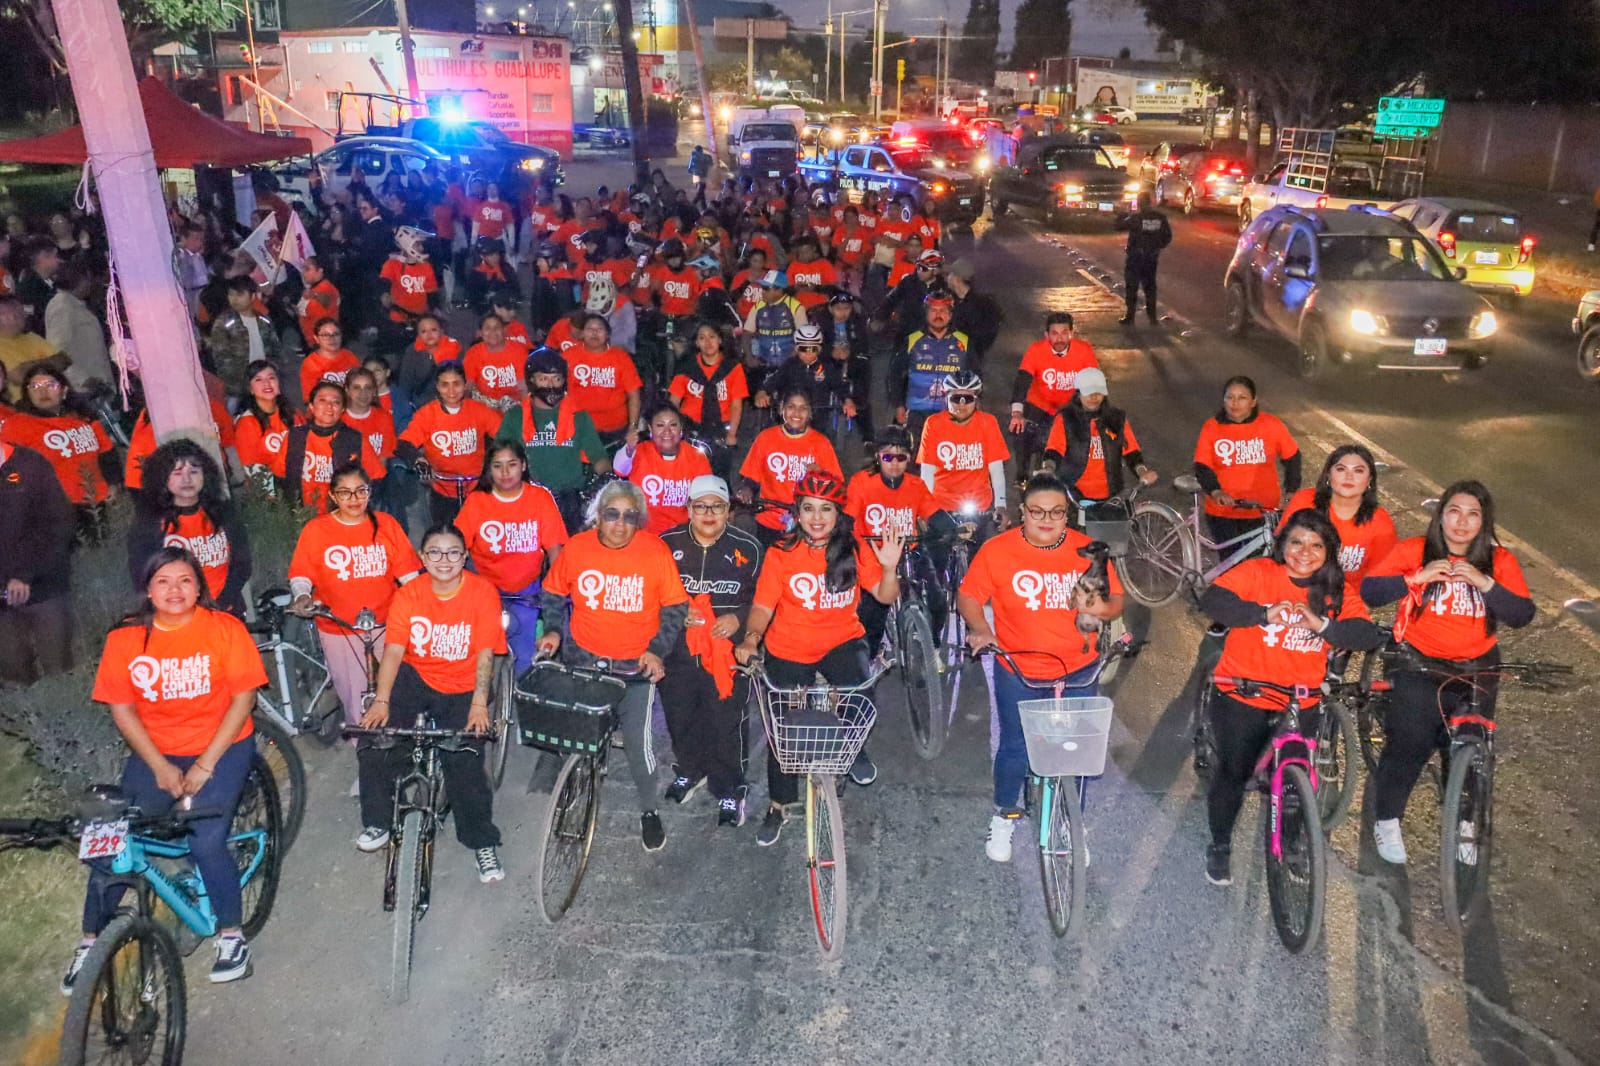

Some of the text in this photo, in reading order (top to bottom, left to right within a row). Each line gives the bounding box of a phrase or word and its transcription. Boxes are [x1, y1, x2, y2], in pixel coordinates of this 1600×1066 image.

[416, 58, 561, 79] ULTIHULES GUADALUPE
[316, 454, 327, 463] NO
[788, 455, 798, 463] NO
[664, 479, 674, 487] NO
[505, 519, 537, 530] NO MÁS
[505, 538, 538, 547] CONTRA
[351, 542, 385, 556] NO MÁS
[199, 552, 228, 562] ONTRA
[353, 561, 386, 571] CONTRA
[606, 573, 644, 586] NO MÁS
[1043, 573, 1059, 583] NO
[1453, 582, 1466, 591] NO
[820, 587, 856, 602] CONTRA
[1045, 593, 1071, 602] CONT
[604, 595, 643, 605] CONTRA
[433, 621, 471, 634] NO MÁS
[430, 644, 469, 655] CONTRA
[161, 653, 210, 671] NO MÁS
[162, 680, 210, 692] CONTRA
[88, 835, 121, 854] 229
